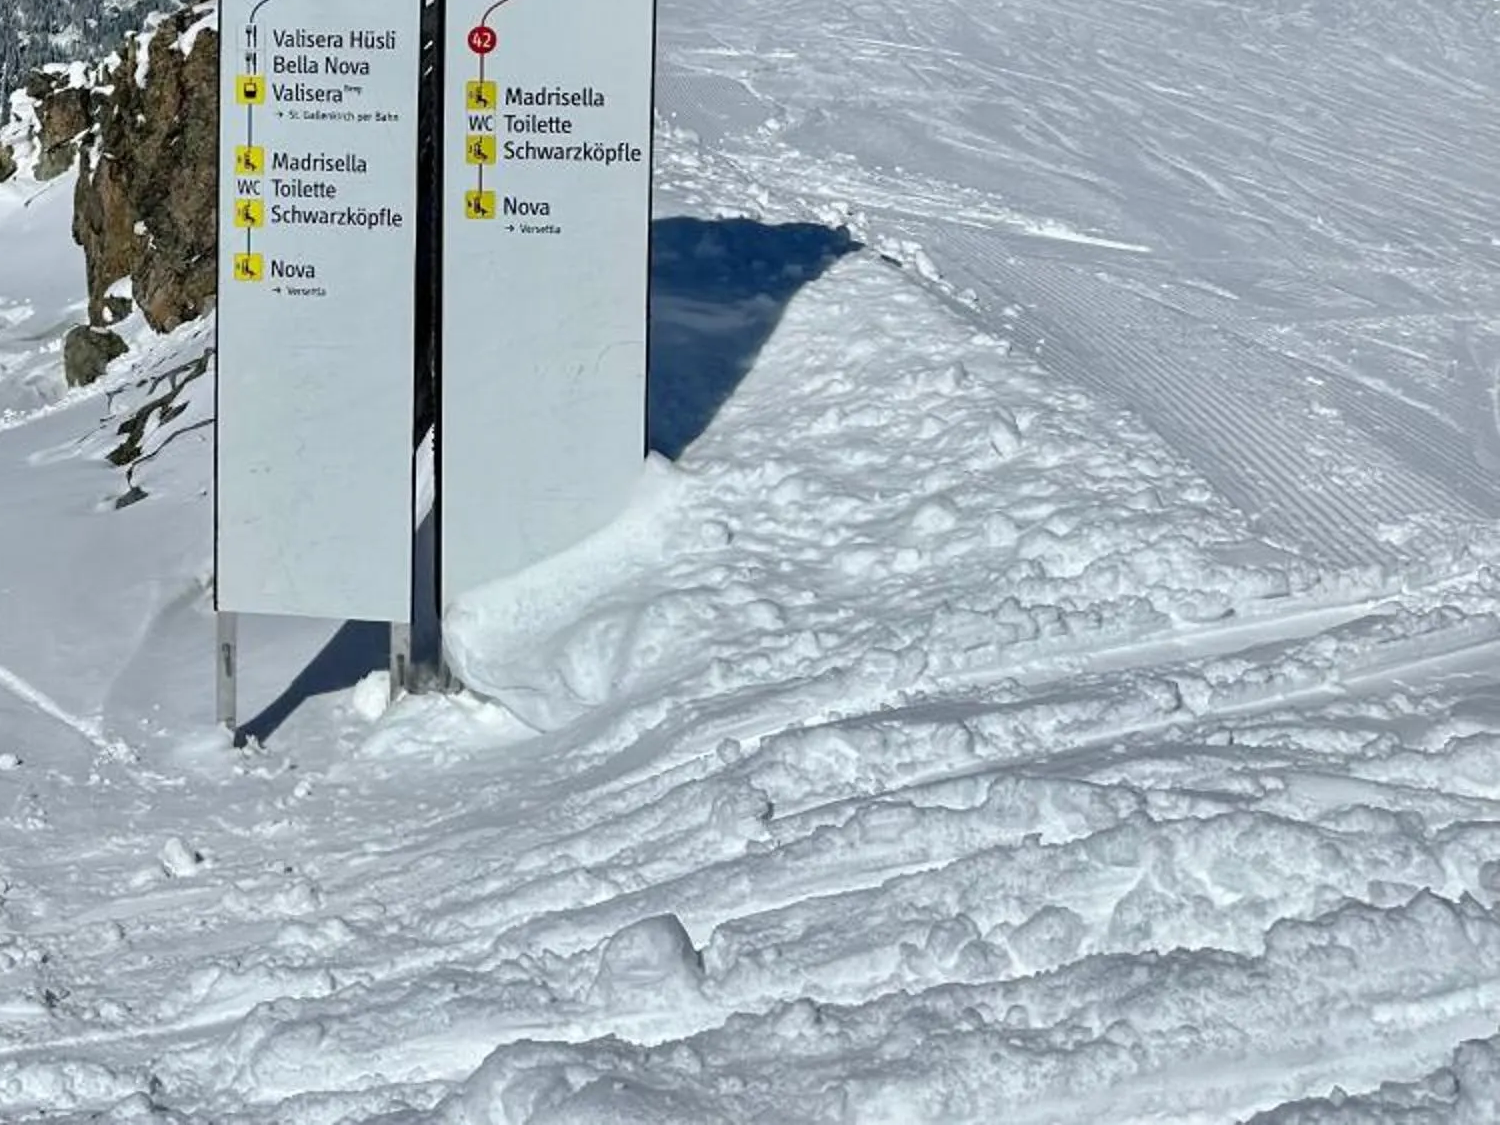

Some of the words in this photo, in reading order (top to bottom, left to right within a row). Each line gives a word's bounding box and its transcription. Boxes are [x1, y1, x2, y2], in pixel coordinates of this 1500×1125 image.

[272, 29, 343, 48] Valisera
[350, 30, 397, 50] Hüsli
[473, 32, 492, 48] 42
[273, 55, 319, 74] Bella
[325, 56, 370, 75] Nova
[272, 83, 343, 103] Valisera
[505, 86, 605, 107] Madrisella
[468, 115, 493, 132] WC
[503, 114, 572, 134] Toilette
[272, 152, 367, 173] Madrisella
[503, 141, 642, 166] Schwarzköpfle
[237, 179, 261, 195] WC
[271, 178, 337, 198] Toilette
[503, 196, 550, 216] Nova
[270, 205, 403, 230] Schwarzköpfle
[270, 259, 315, 278] Nova
